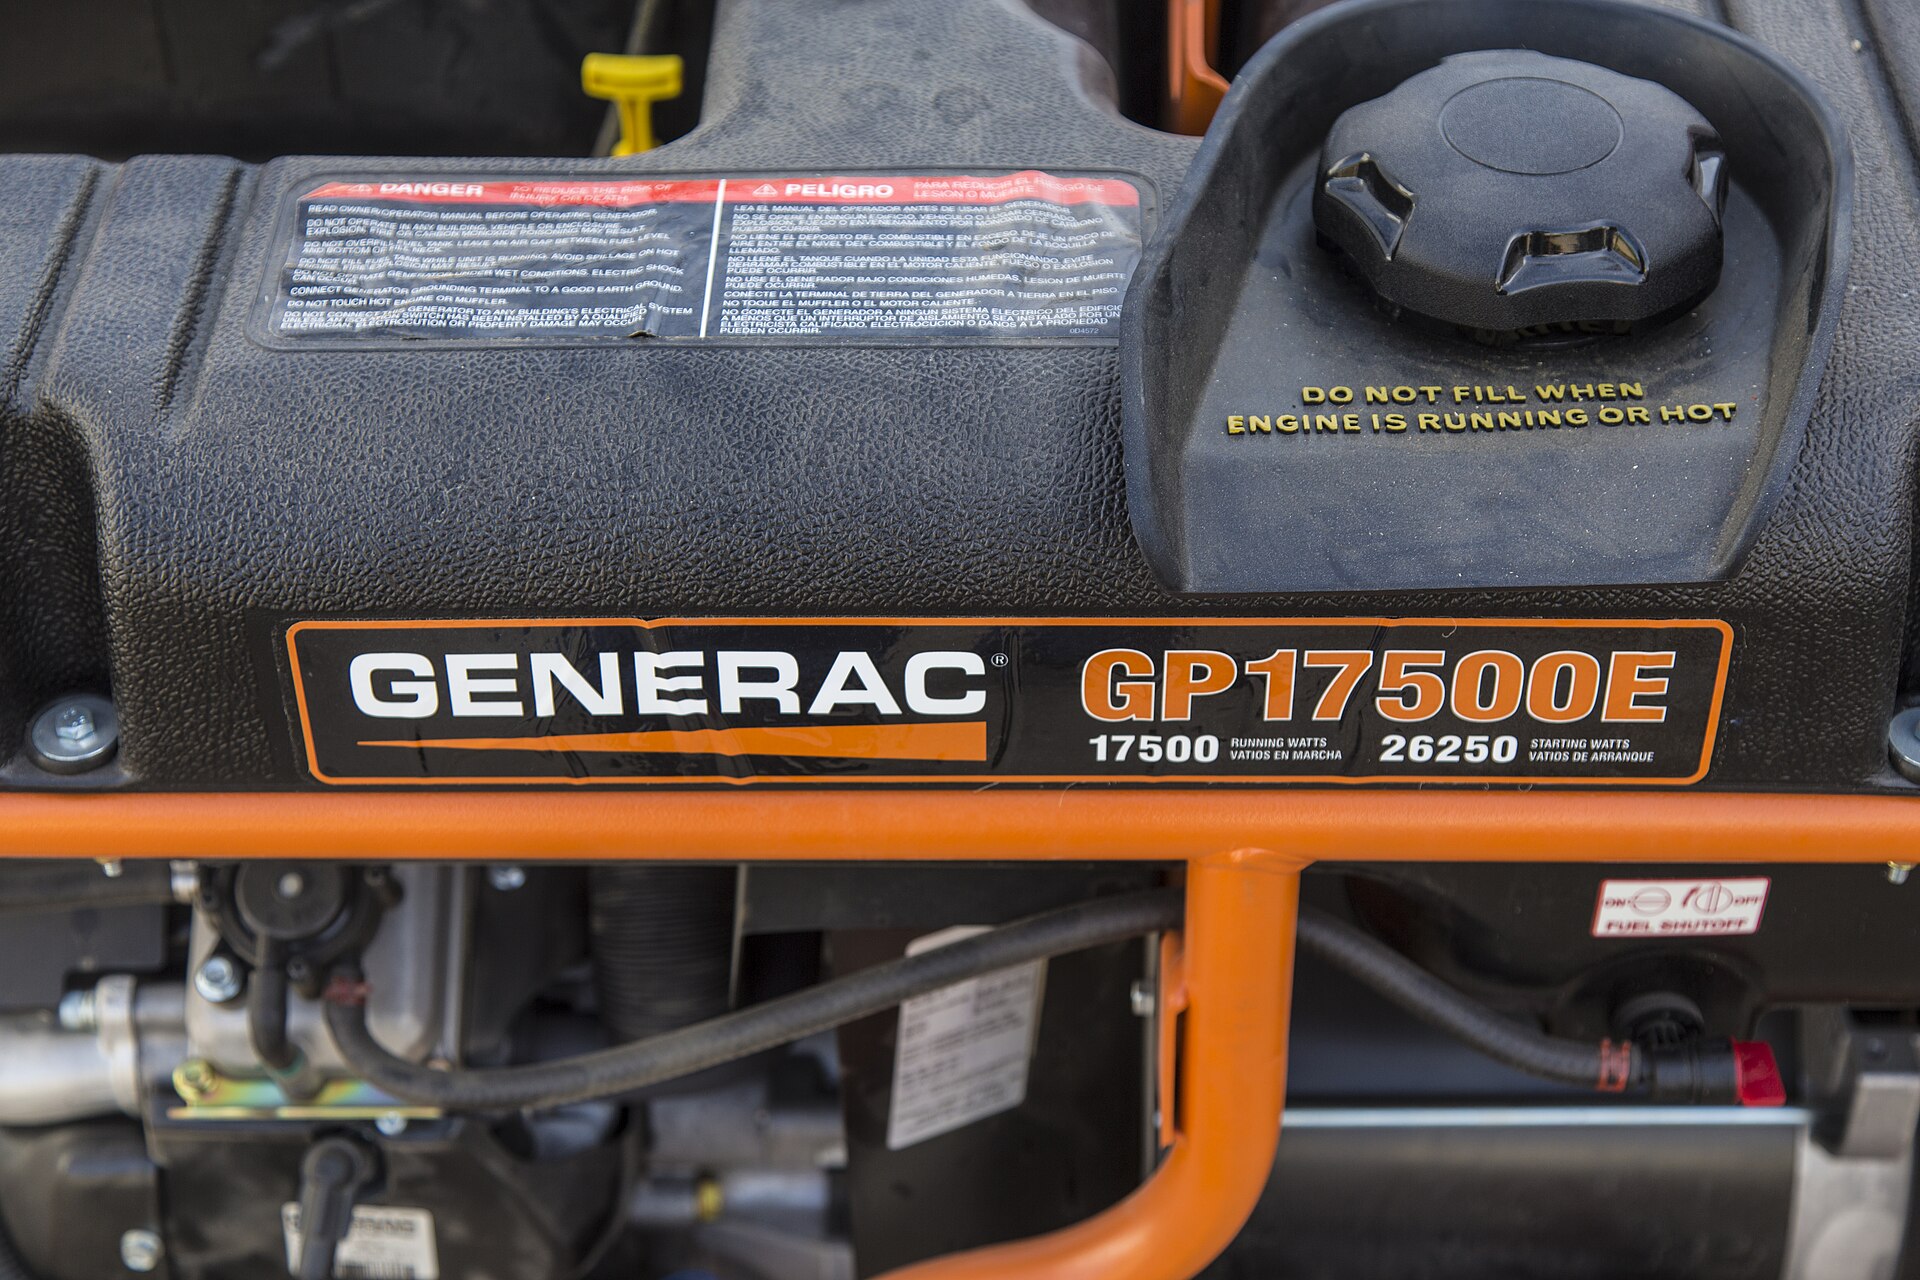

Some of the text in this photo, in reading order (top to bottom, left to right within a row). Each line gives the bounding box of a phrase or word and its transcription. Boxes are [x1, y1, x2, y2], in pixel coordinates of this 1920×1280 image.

[380, 183, 483, 197] DANGER
[785, 184, 894, 198] PELIGRO
[966, 274, 1022, 282] HUMEDAS.
[1083, 272, 1126, 281] MUERTE
[290, 286, 342, 295] CONNECT
[344, 286, 409, 295] GENERATOR
[411, 284, 476, 294] GROUNDING
[936, 288, 1004, 298] GENERADOR
[330, 298, 367, 307] TOUCH
[368, 298, 392, 306] HOT
[394, 294, 434, 306] ENGINE
[408, 306, 474, 314] GENERATOR
[581, 302, 646, 314] ELECTRICAL
[648, 302, 692, 314] SYSTEM
[940, 307, 990, 315] SISTEMA
[992, 308, 1053, 316] ELECTRICO
[356, 318, 446, 328] ELECTROCUTION
[918, 314, 990, 322] AISLAMIENTO
[1018, 313, 1076, 321] INSTALADO
[870, 320, 964, 328] ELECTROCUCION
[1302, 382, 1644, 405] DO NOT FILL WHEN
[1227, 401, 1737, 436] ENGINE IS RUNNING OR HOT
[349, 651, 987, 719] GENERAC
[1081, 648, 1677, 724] GP17500E
[1230, 736, 1328, 748] RUNNING WATTS
[1529, 738, 1630, 750] STARTING WATTS
[1088, 734, 1220, 763] 17500
[1230, 748, 1342, 761] VATIOS EN MARCHA
[1380, 734, 1519, 764] 26250
[1528, 750, 1654, 762] VATIOS DE ARRANQUE
[1606, 918, 1748, 931] FUEL SHUTOFF
